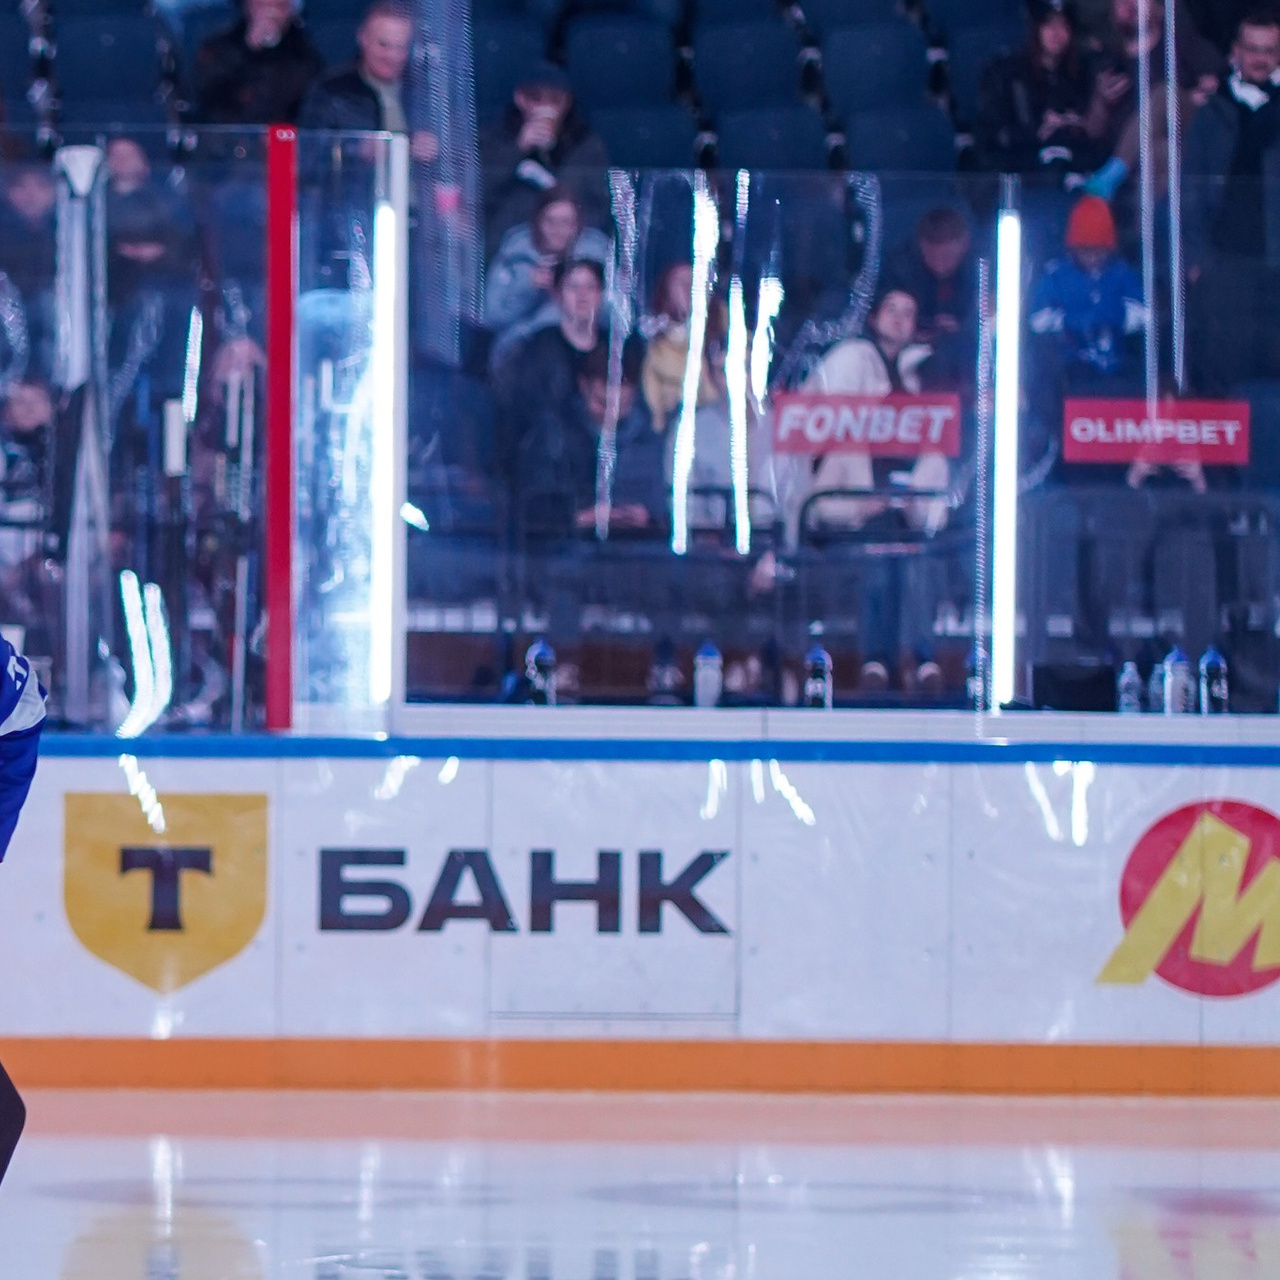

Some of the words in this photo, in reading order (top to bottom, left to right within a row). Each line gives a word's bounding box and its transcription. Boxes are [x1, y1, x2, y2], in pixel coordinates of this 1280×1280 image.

[777, 403, 955, 444] FONBET
[1070, 416, 1242, 447] OLIMPBET
[318, 847, 732, 936] БАНК
